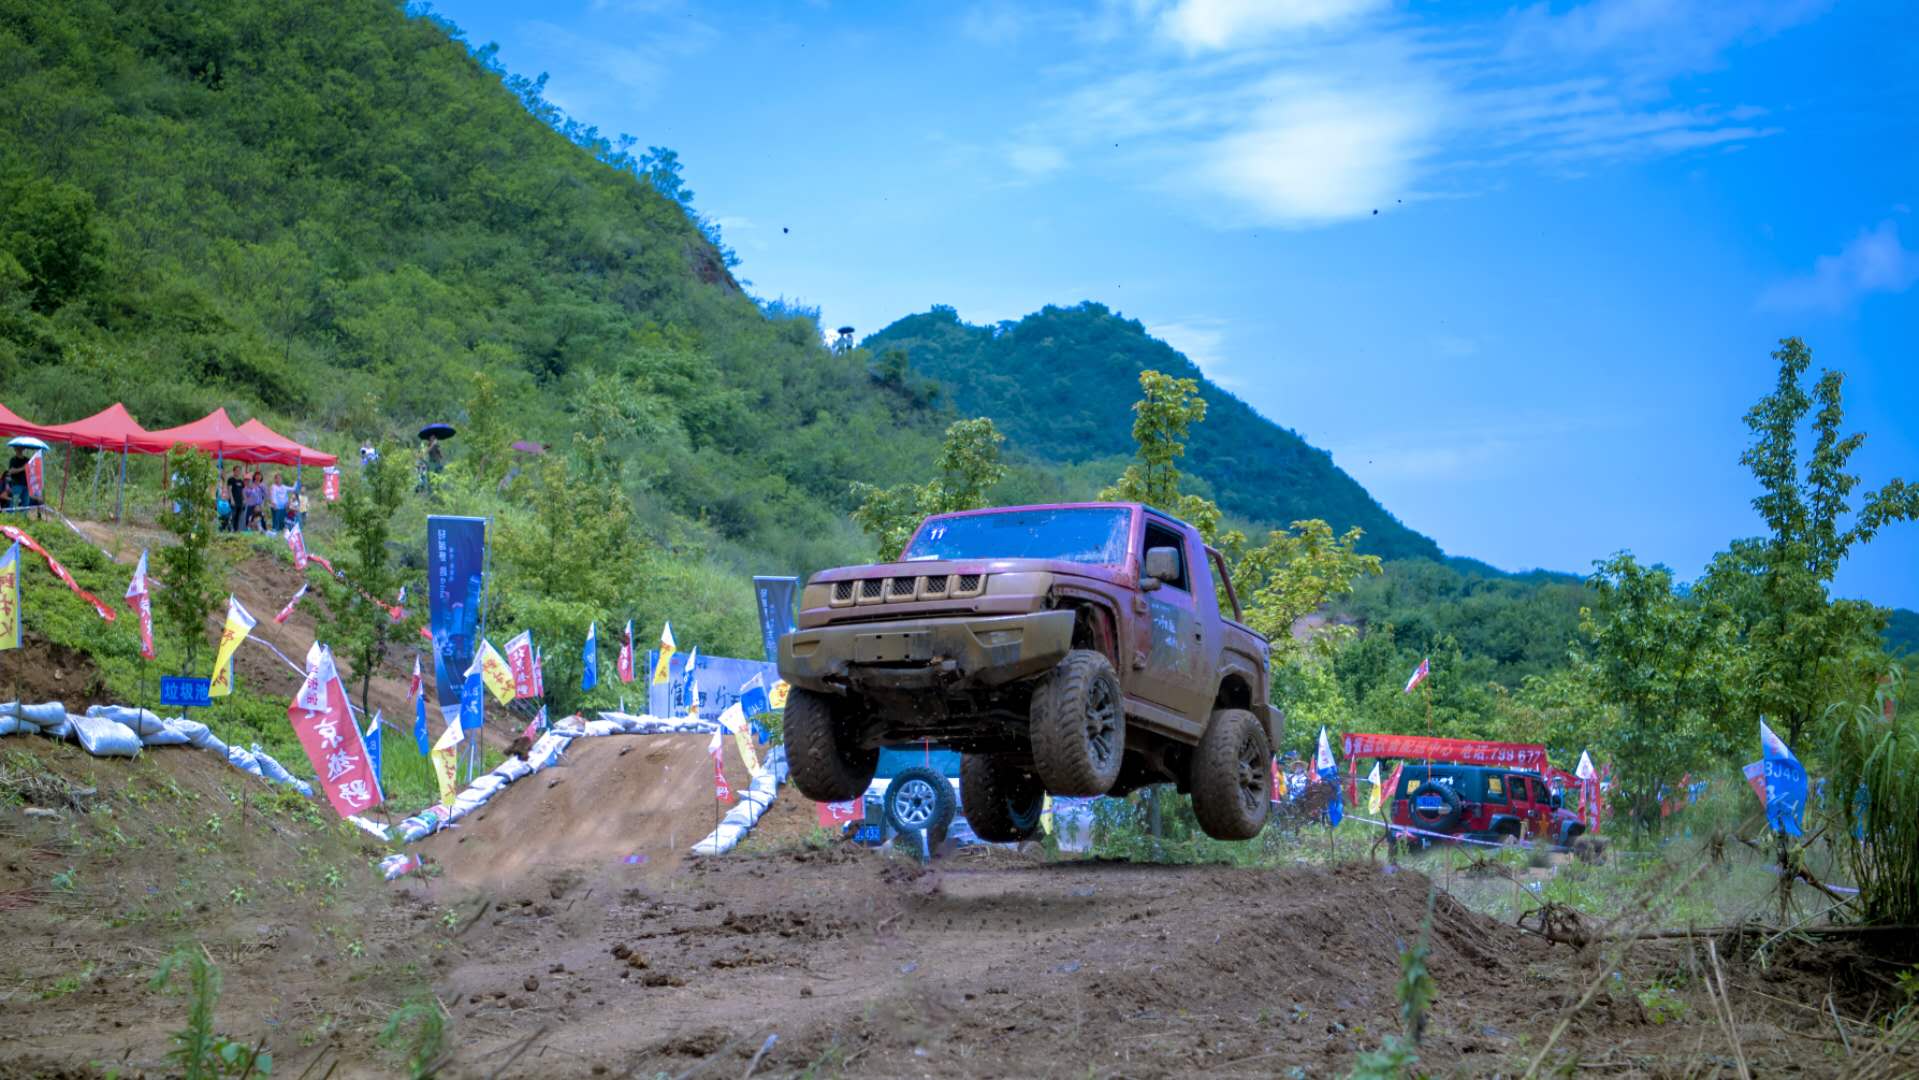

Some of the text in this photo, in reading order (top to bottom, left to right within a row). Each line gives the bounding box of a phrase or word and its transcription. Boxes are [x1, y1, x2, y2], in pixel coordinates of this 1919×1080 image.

[931, 528, 945, 540] 11
[164, 682, 209, 701] 垃圾池
[1764, 761, 1799, 782] BJ40
